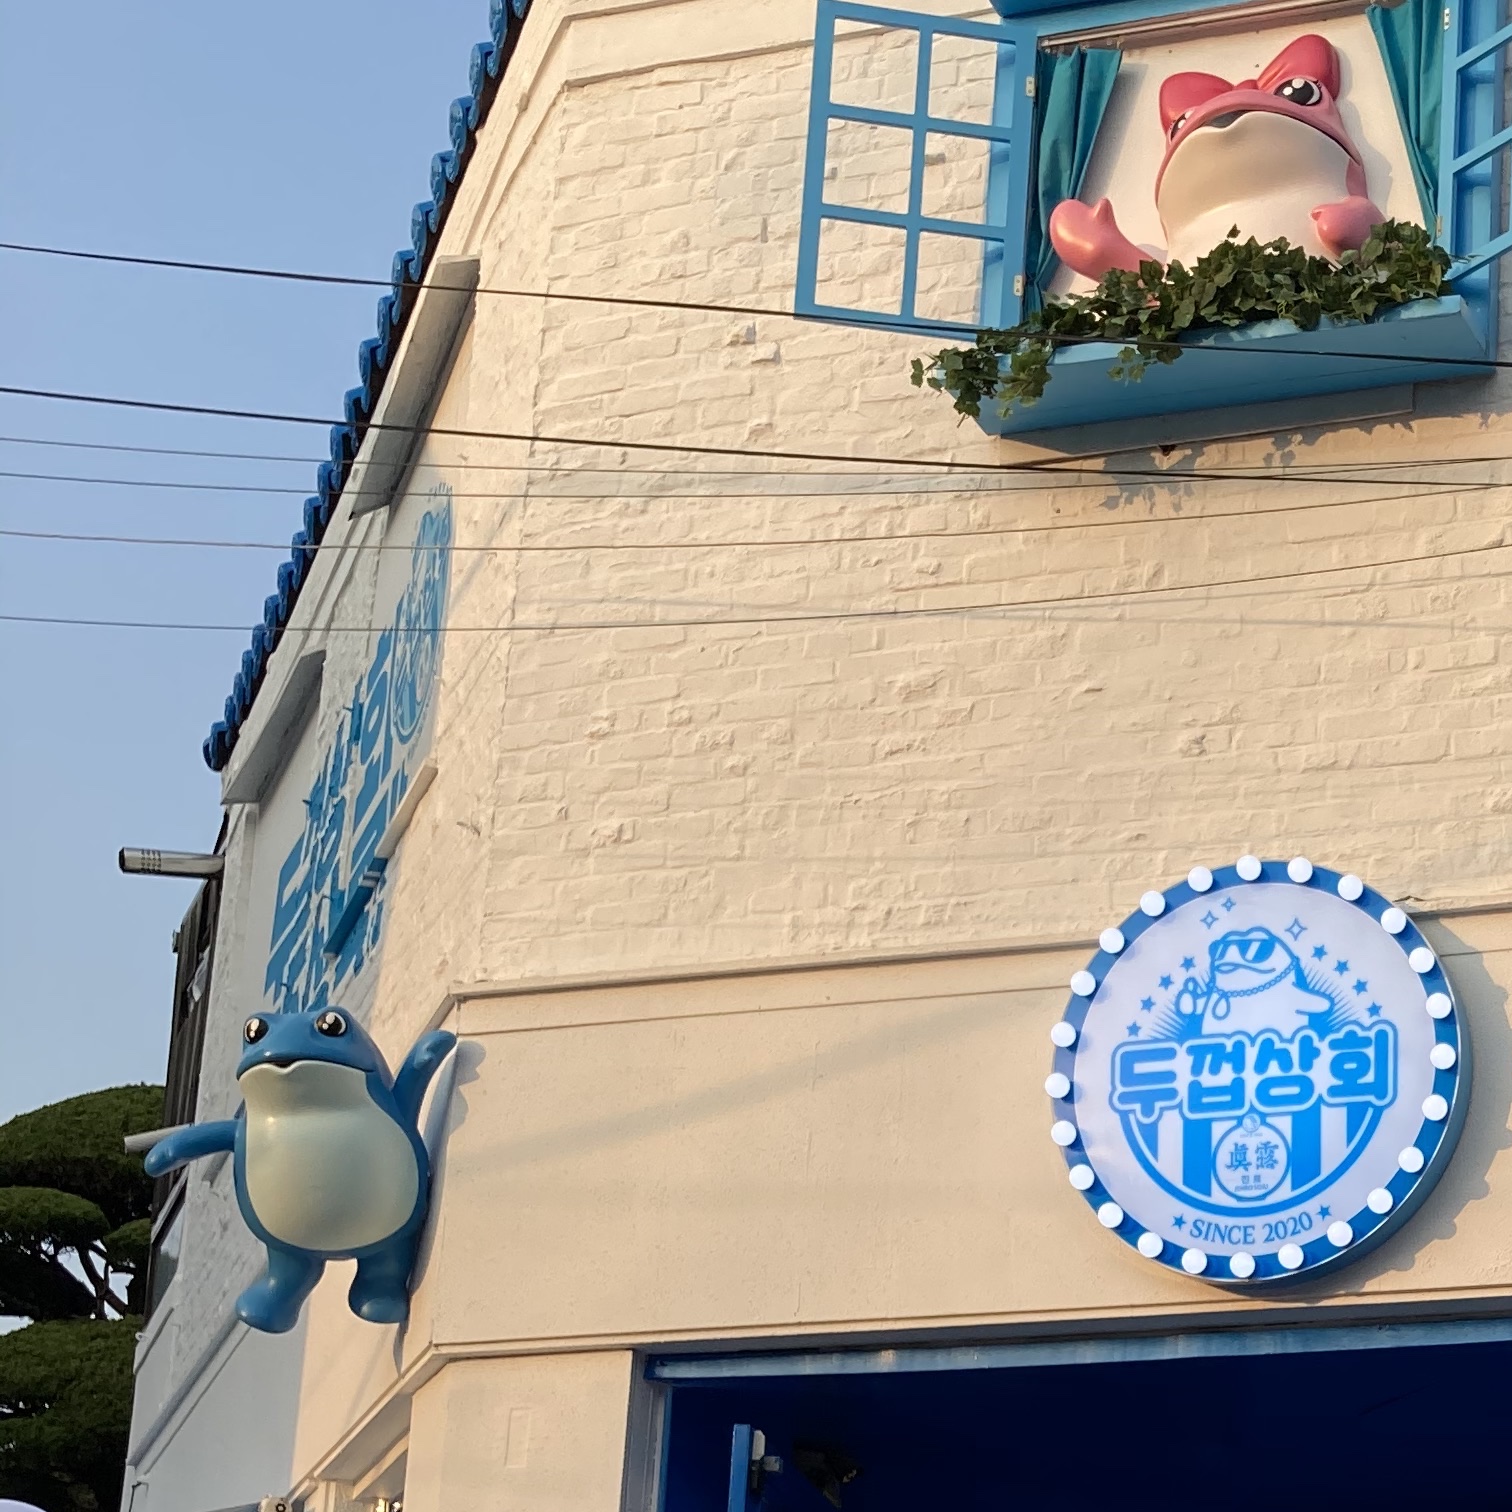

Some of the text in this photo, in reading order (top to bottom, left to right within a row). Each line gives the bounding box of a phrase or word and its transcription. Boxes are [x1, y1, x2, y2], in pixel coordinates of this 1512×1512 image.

[1114, 1026, 1393, 1119] 두껍상회
[1189, 1210, 1314, 1245] SINCE 2020
